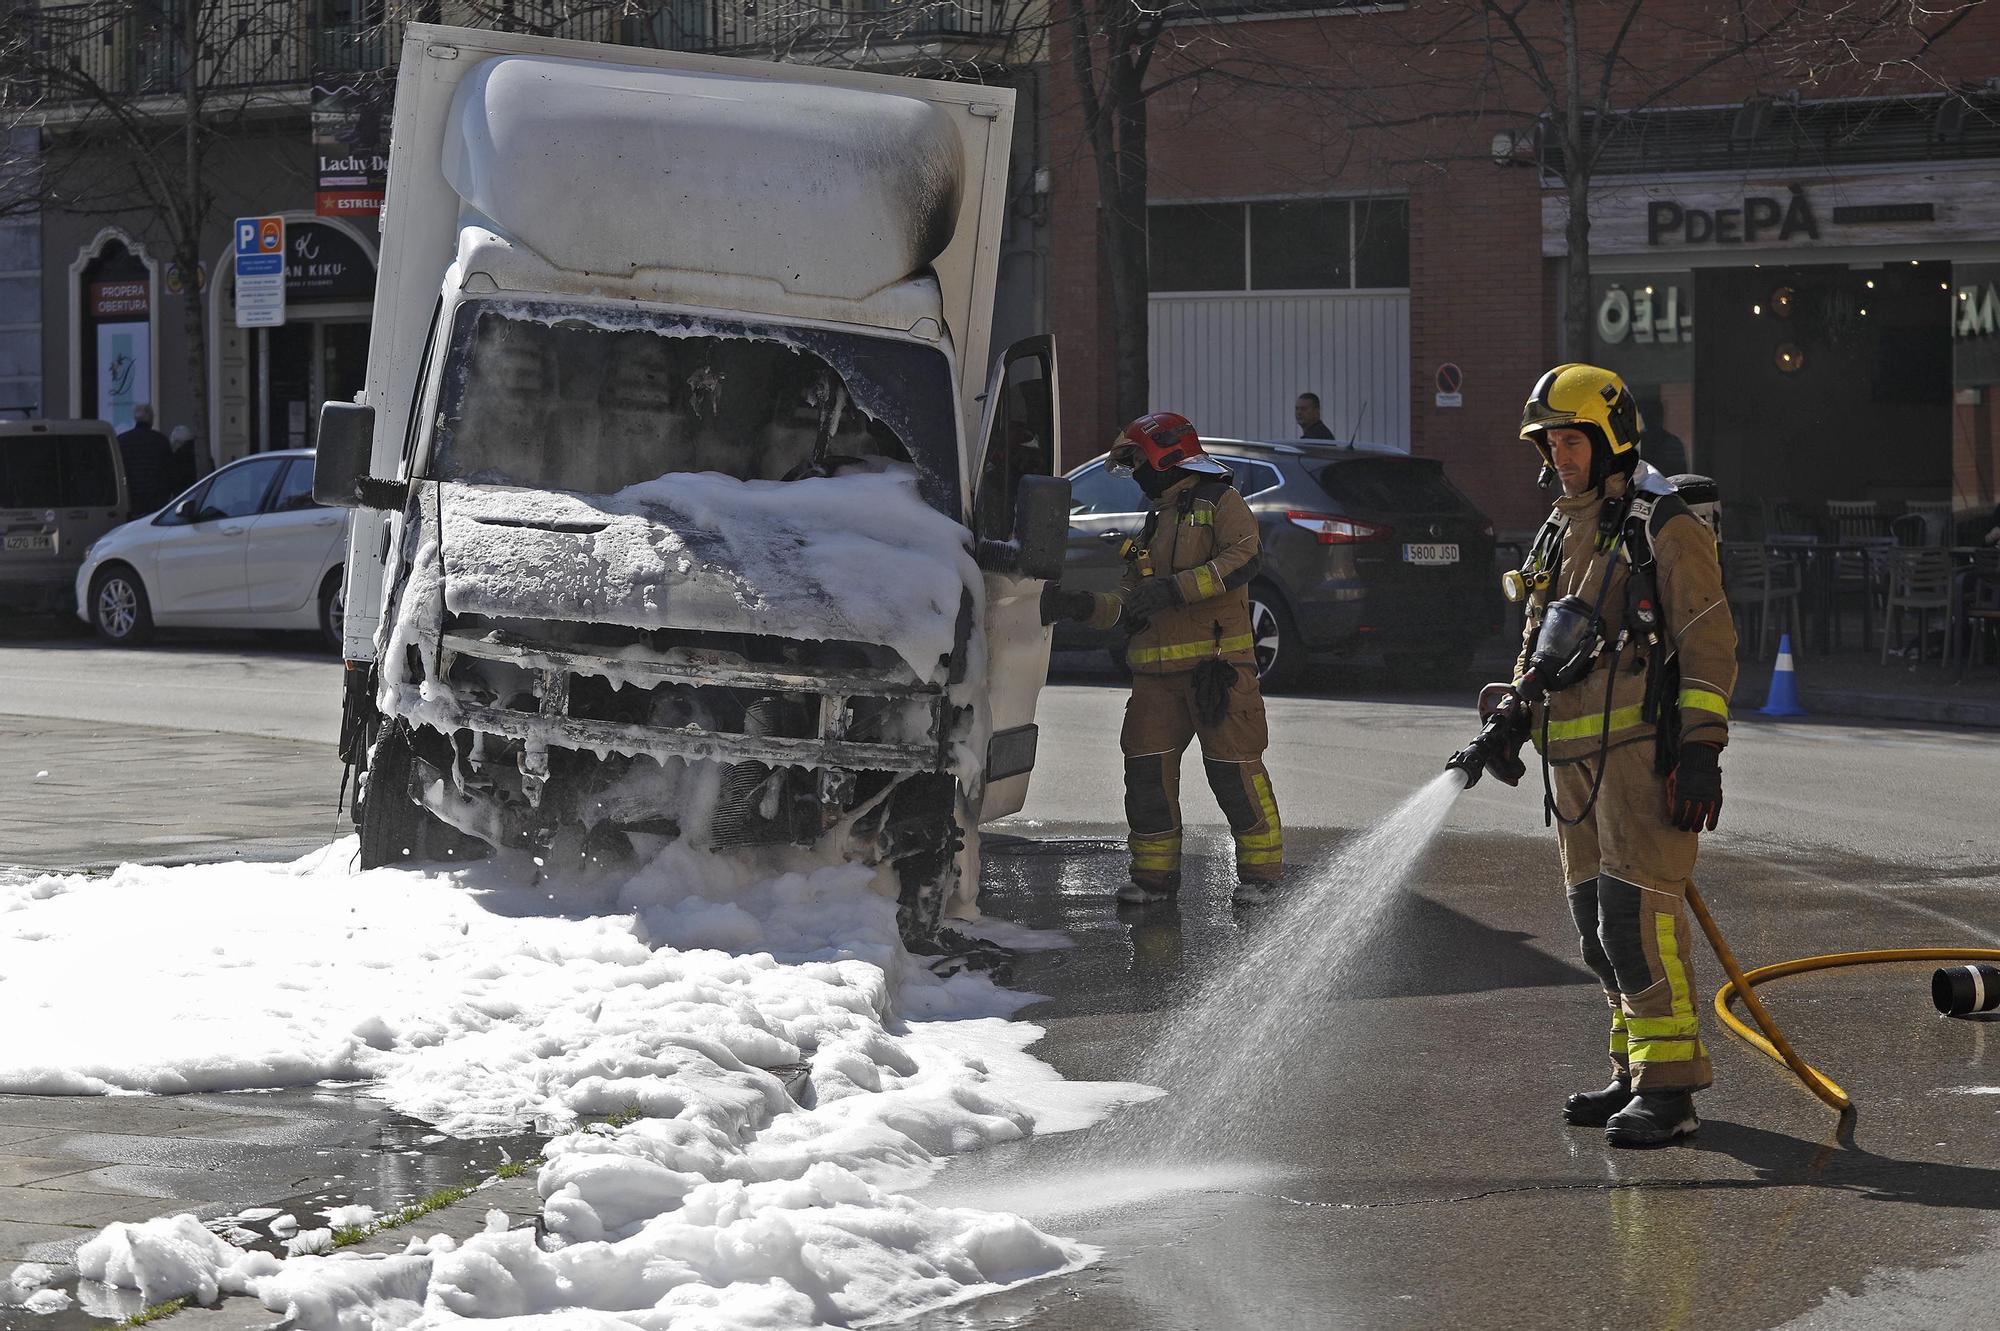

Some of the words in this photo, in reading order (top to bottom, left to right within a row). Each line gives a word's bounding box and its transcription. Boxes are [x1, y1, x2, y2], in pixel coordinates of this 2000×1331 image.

[320, 155, 368, 174] Lachy
[337, 199, 384, 209] ESTRELL
[240, 224, 255, 250] P
[285, 265, 303, 278] AN
[309, 263, 342, 276] KIKU
[102, 285, 145, 298] PROPERA
[98, 300, 147, 313] OBERTURA
[1631, 502, 1650, 516] SA
[1411, 546, 1436, 560] 5800
[1440, 546, 1458, 560] JSD
